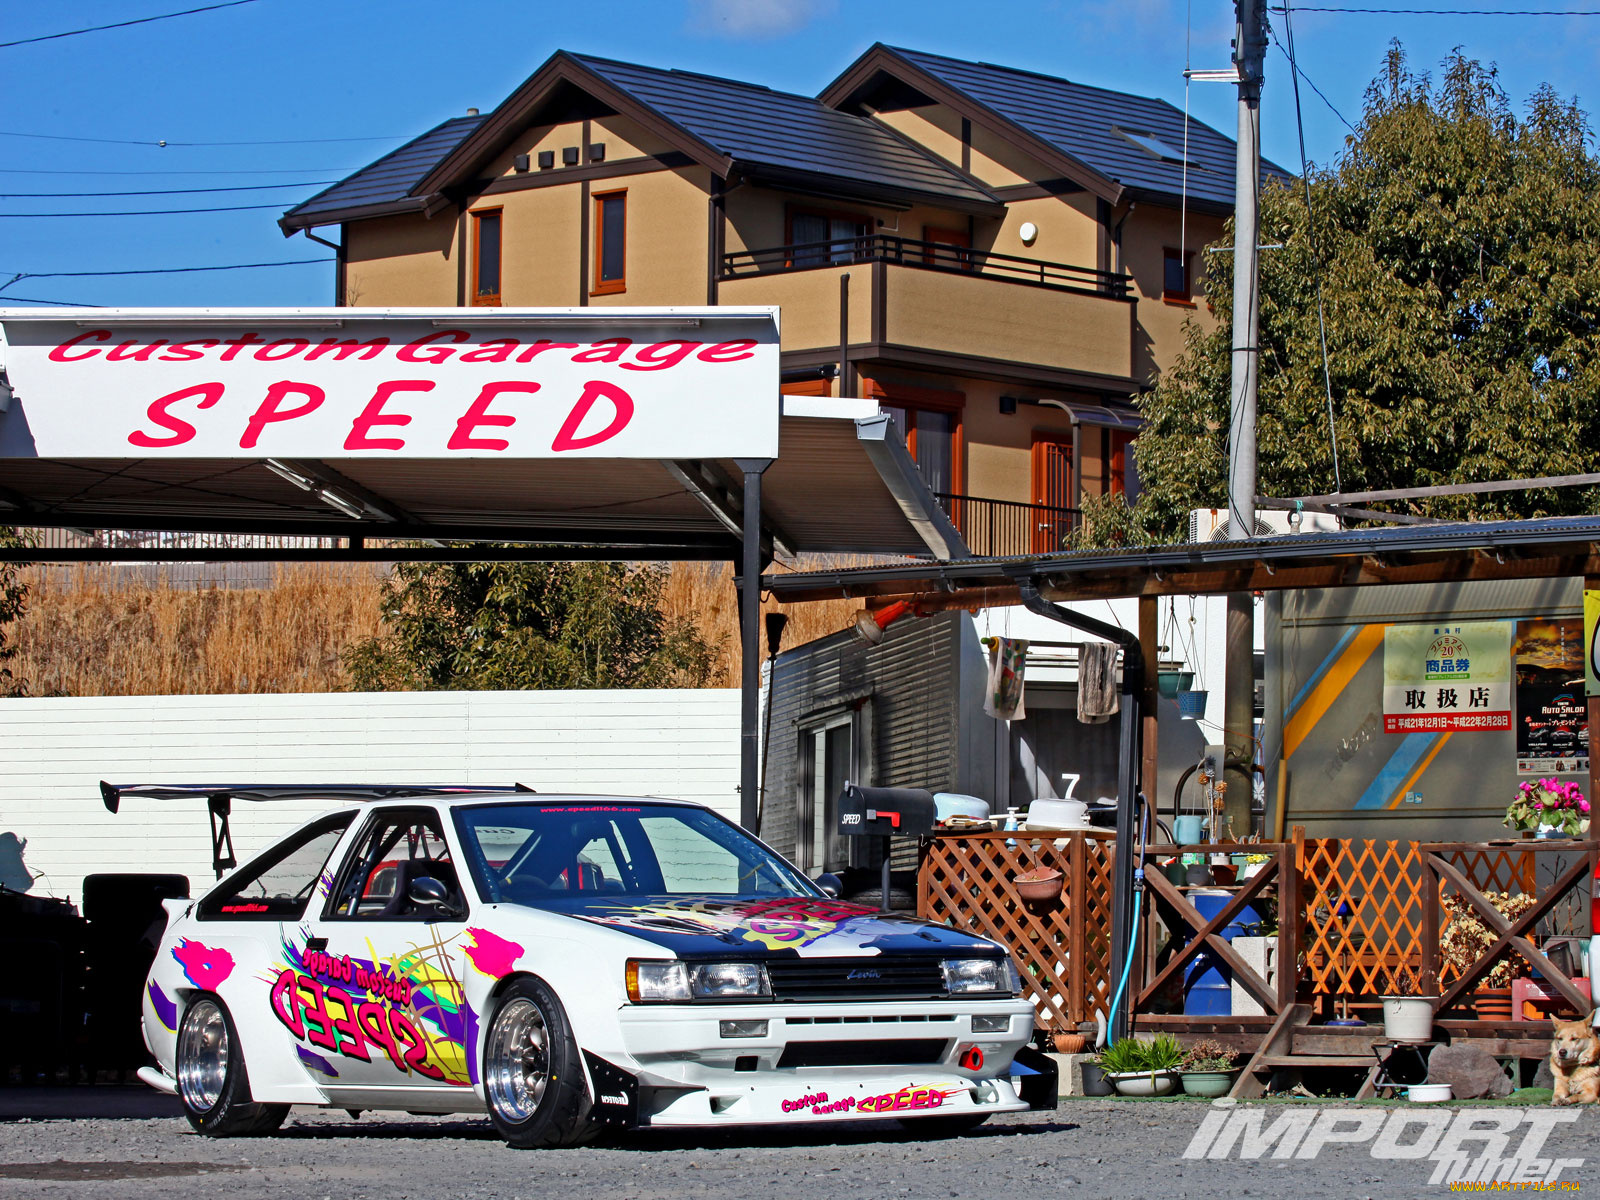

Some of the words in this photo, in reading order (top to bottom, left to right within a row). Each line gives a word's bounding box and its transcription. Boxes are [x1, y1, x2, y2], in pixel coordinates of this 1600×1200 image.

[127, 379, 635, 453] SPEED
[1441, 646, 1454, 656] 20
[1426, 658, 1470, 673] 商品券
[1405, 687, 1490, 709] 取扱店
[1062, 773, 1081, 799] 7
[841, 813, 861, 825] SPEED
[781, 1092, 829, 1113] Custom
[812, 1096, 856, 1115] Garage
[856, 1089, 943, 1112] SPEED
